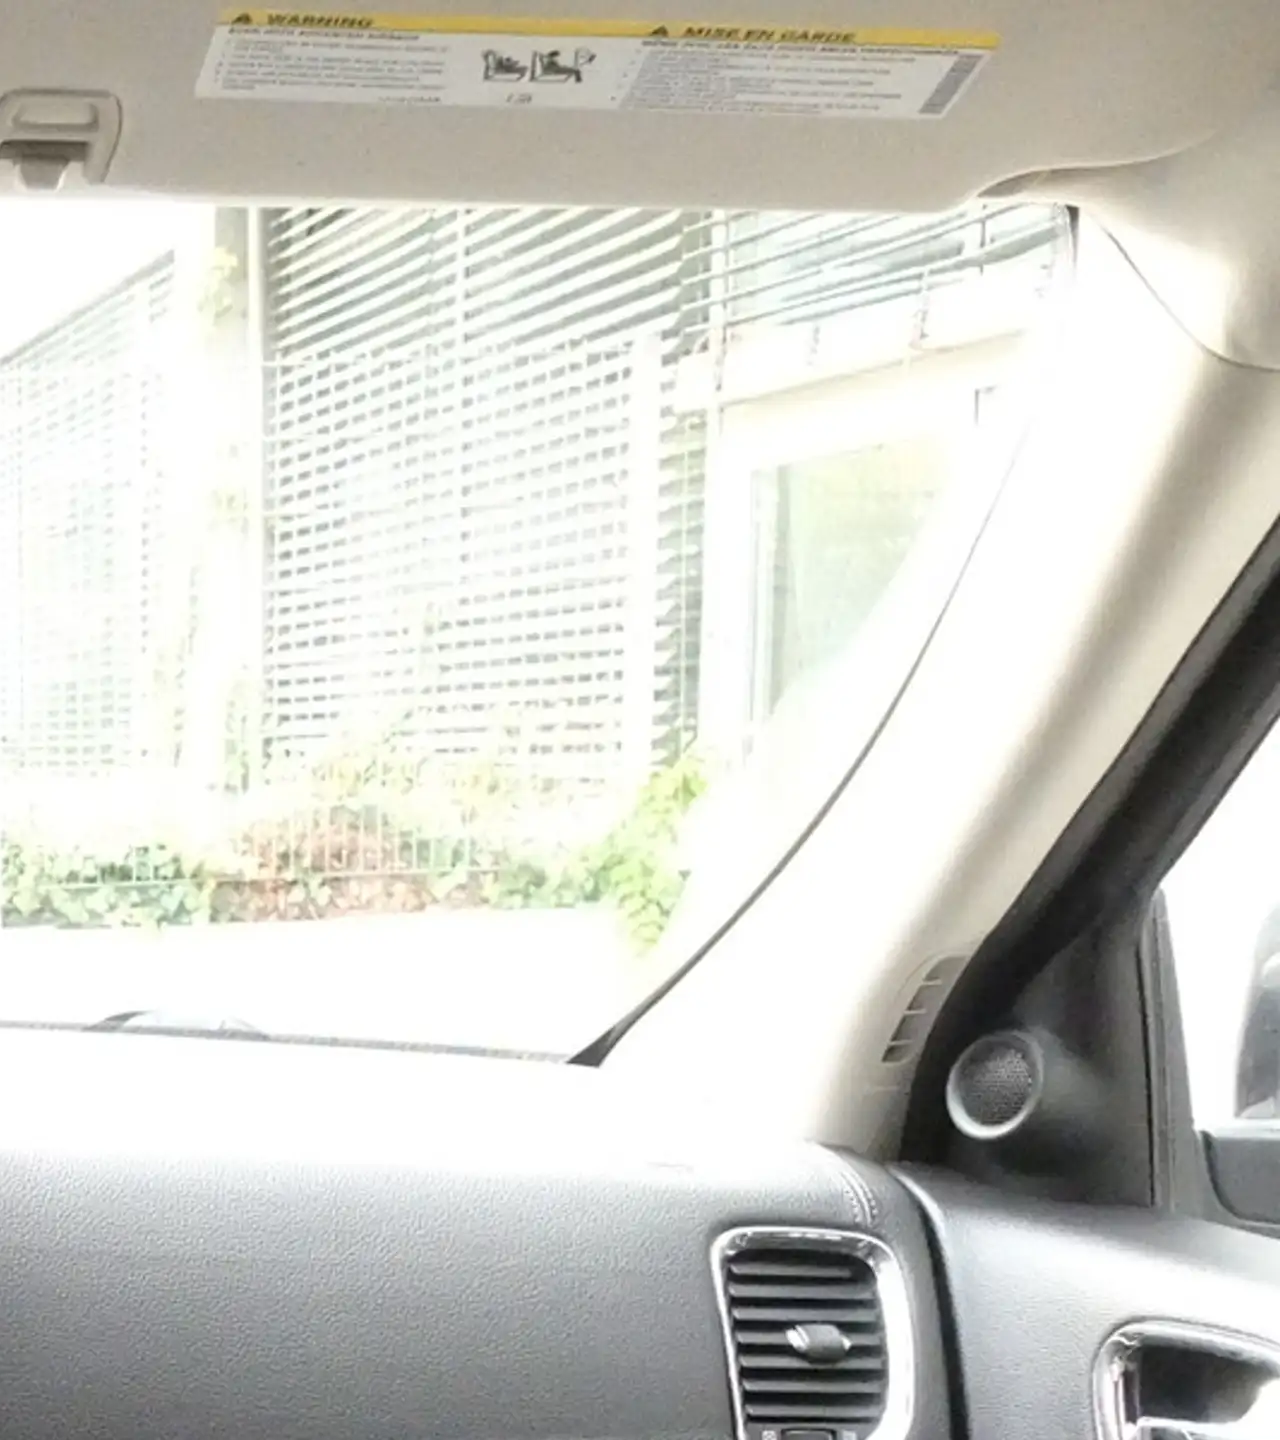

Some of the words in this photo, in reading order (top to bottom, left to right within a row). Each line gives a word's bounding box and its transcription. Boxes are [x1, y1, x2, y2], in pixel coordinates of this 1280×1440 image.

[267, 14, 375, 29] WARNING
[682, 26, 742, 38] MISE
[744, 29, 775, 41] EN
[779, 31, 857, 44] GARDE
